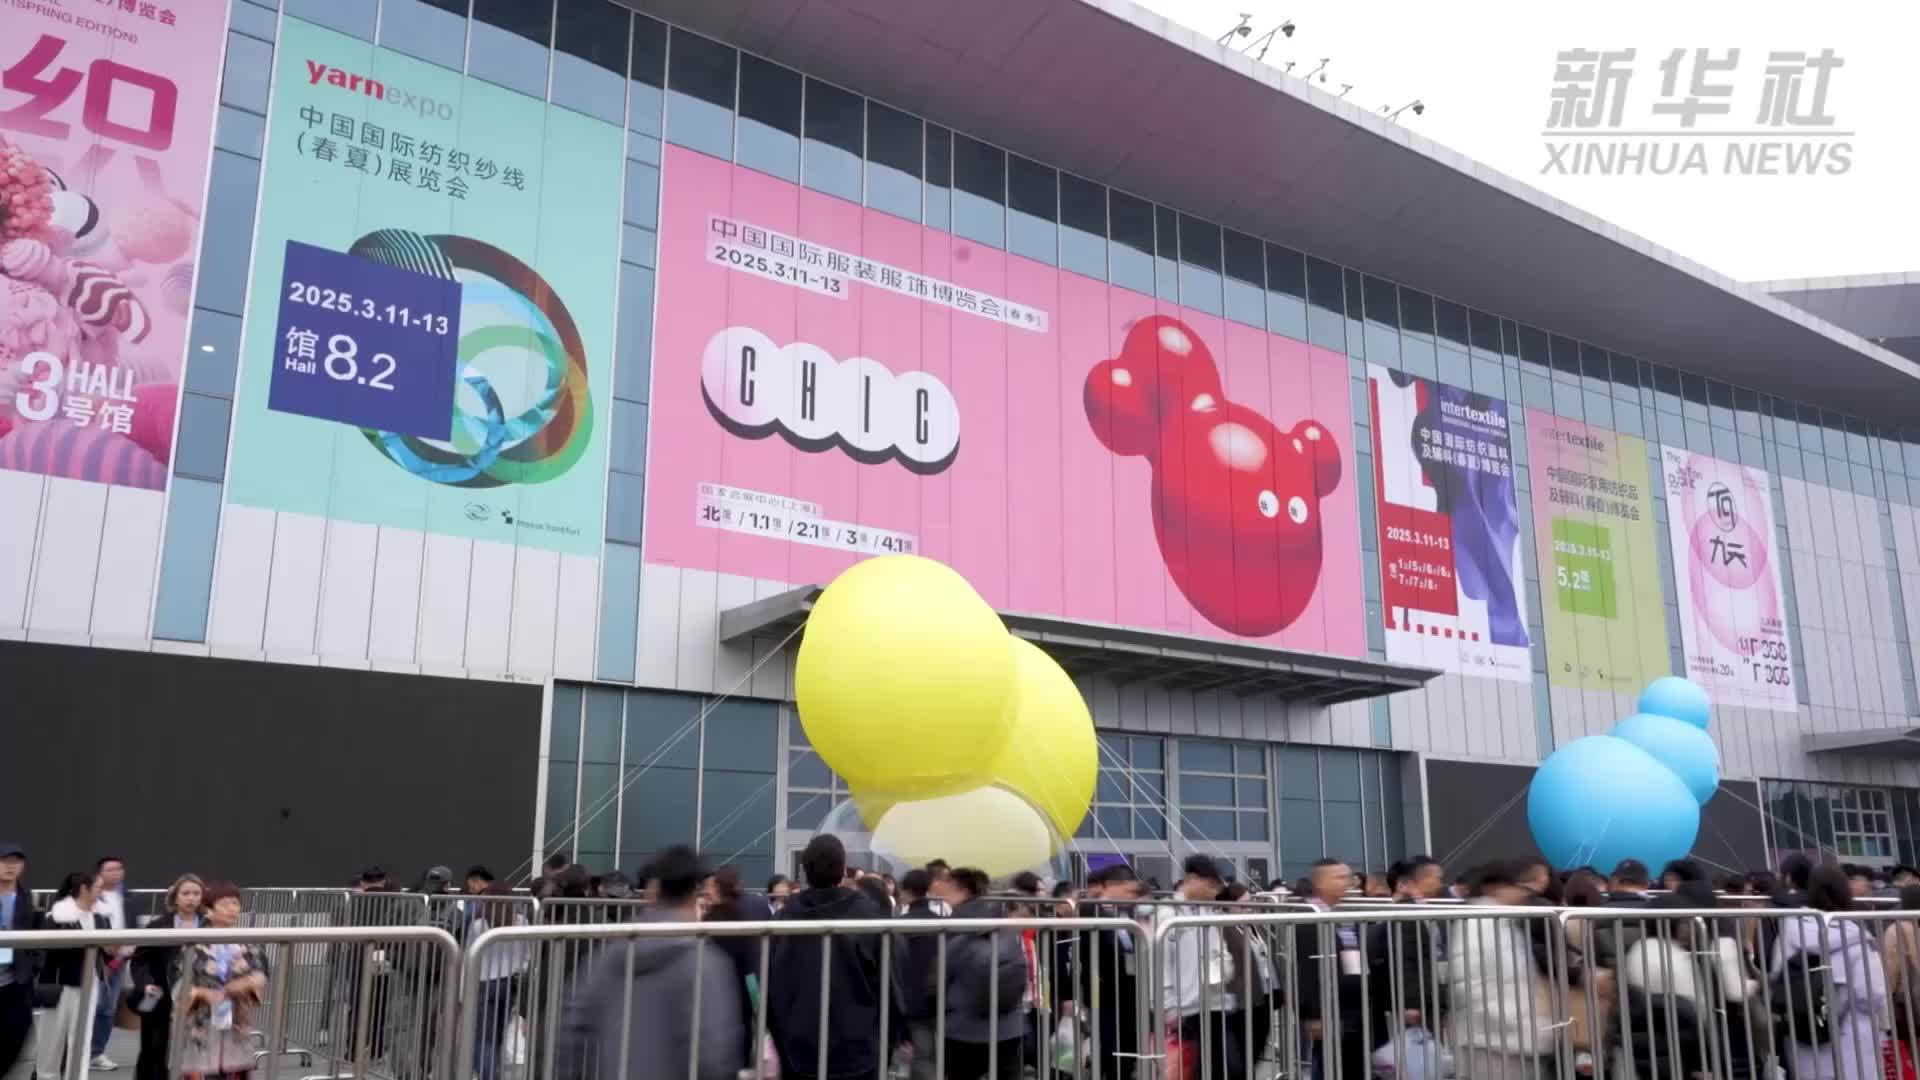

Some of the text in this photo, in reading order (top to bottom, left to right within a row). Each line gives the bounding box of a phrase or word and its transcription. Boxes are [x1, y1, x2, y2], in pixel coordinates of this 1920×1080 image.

[297, 131, 470, 200] (春夏)展览会
[299, 104, 525, 191] 中国国际纺织纱线
[715, 246, 841, 295] 2025.3.11-13
[289, 281, 449, 335] 2025.3.11-13
[285, 326, 397, 391] 馆 8.2
[285, 357, 317, 375] Hall
[15, 351, 137, 421] 3 HALL
[740, 345, 929, 445] CHIC
[63, 397, 134, 434] 号馆
[1441, 400, 1506, 428] intertextile
[1387, 526, 1450, 550] 2025.3.11-13
